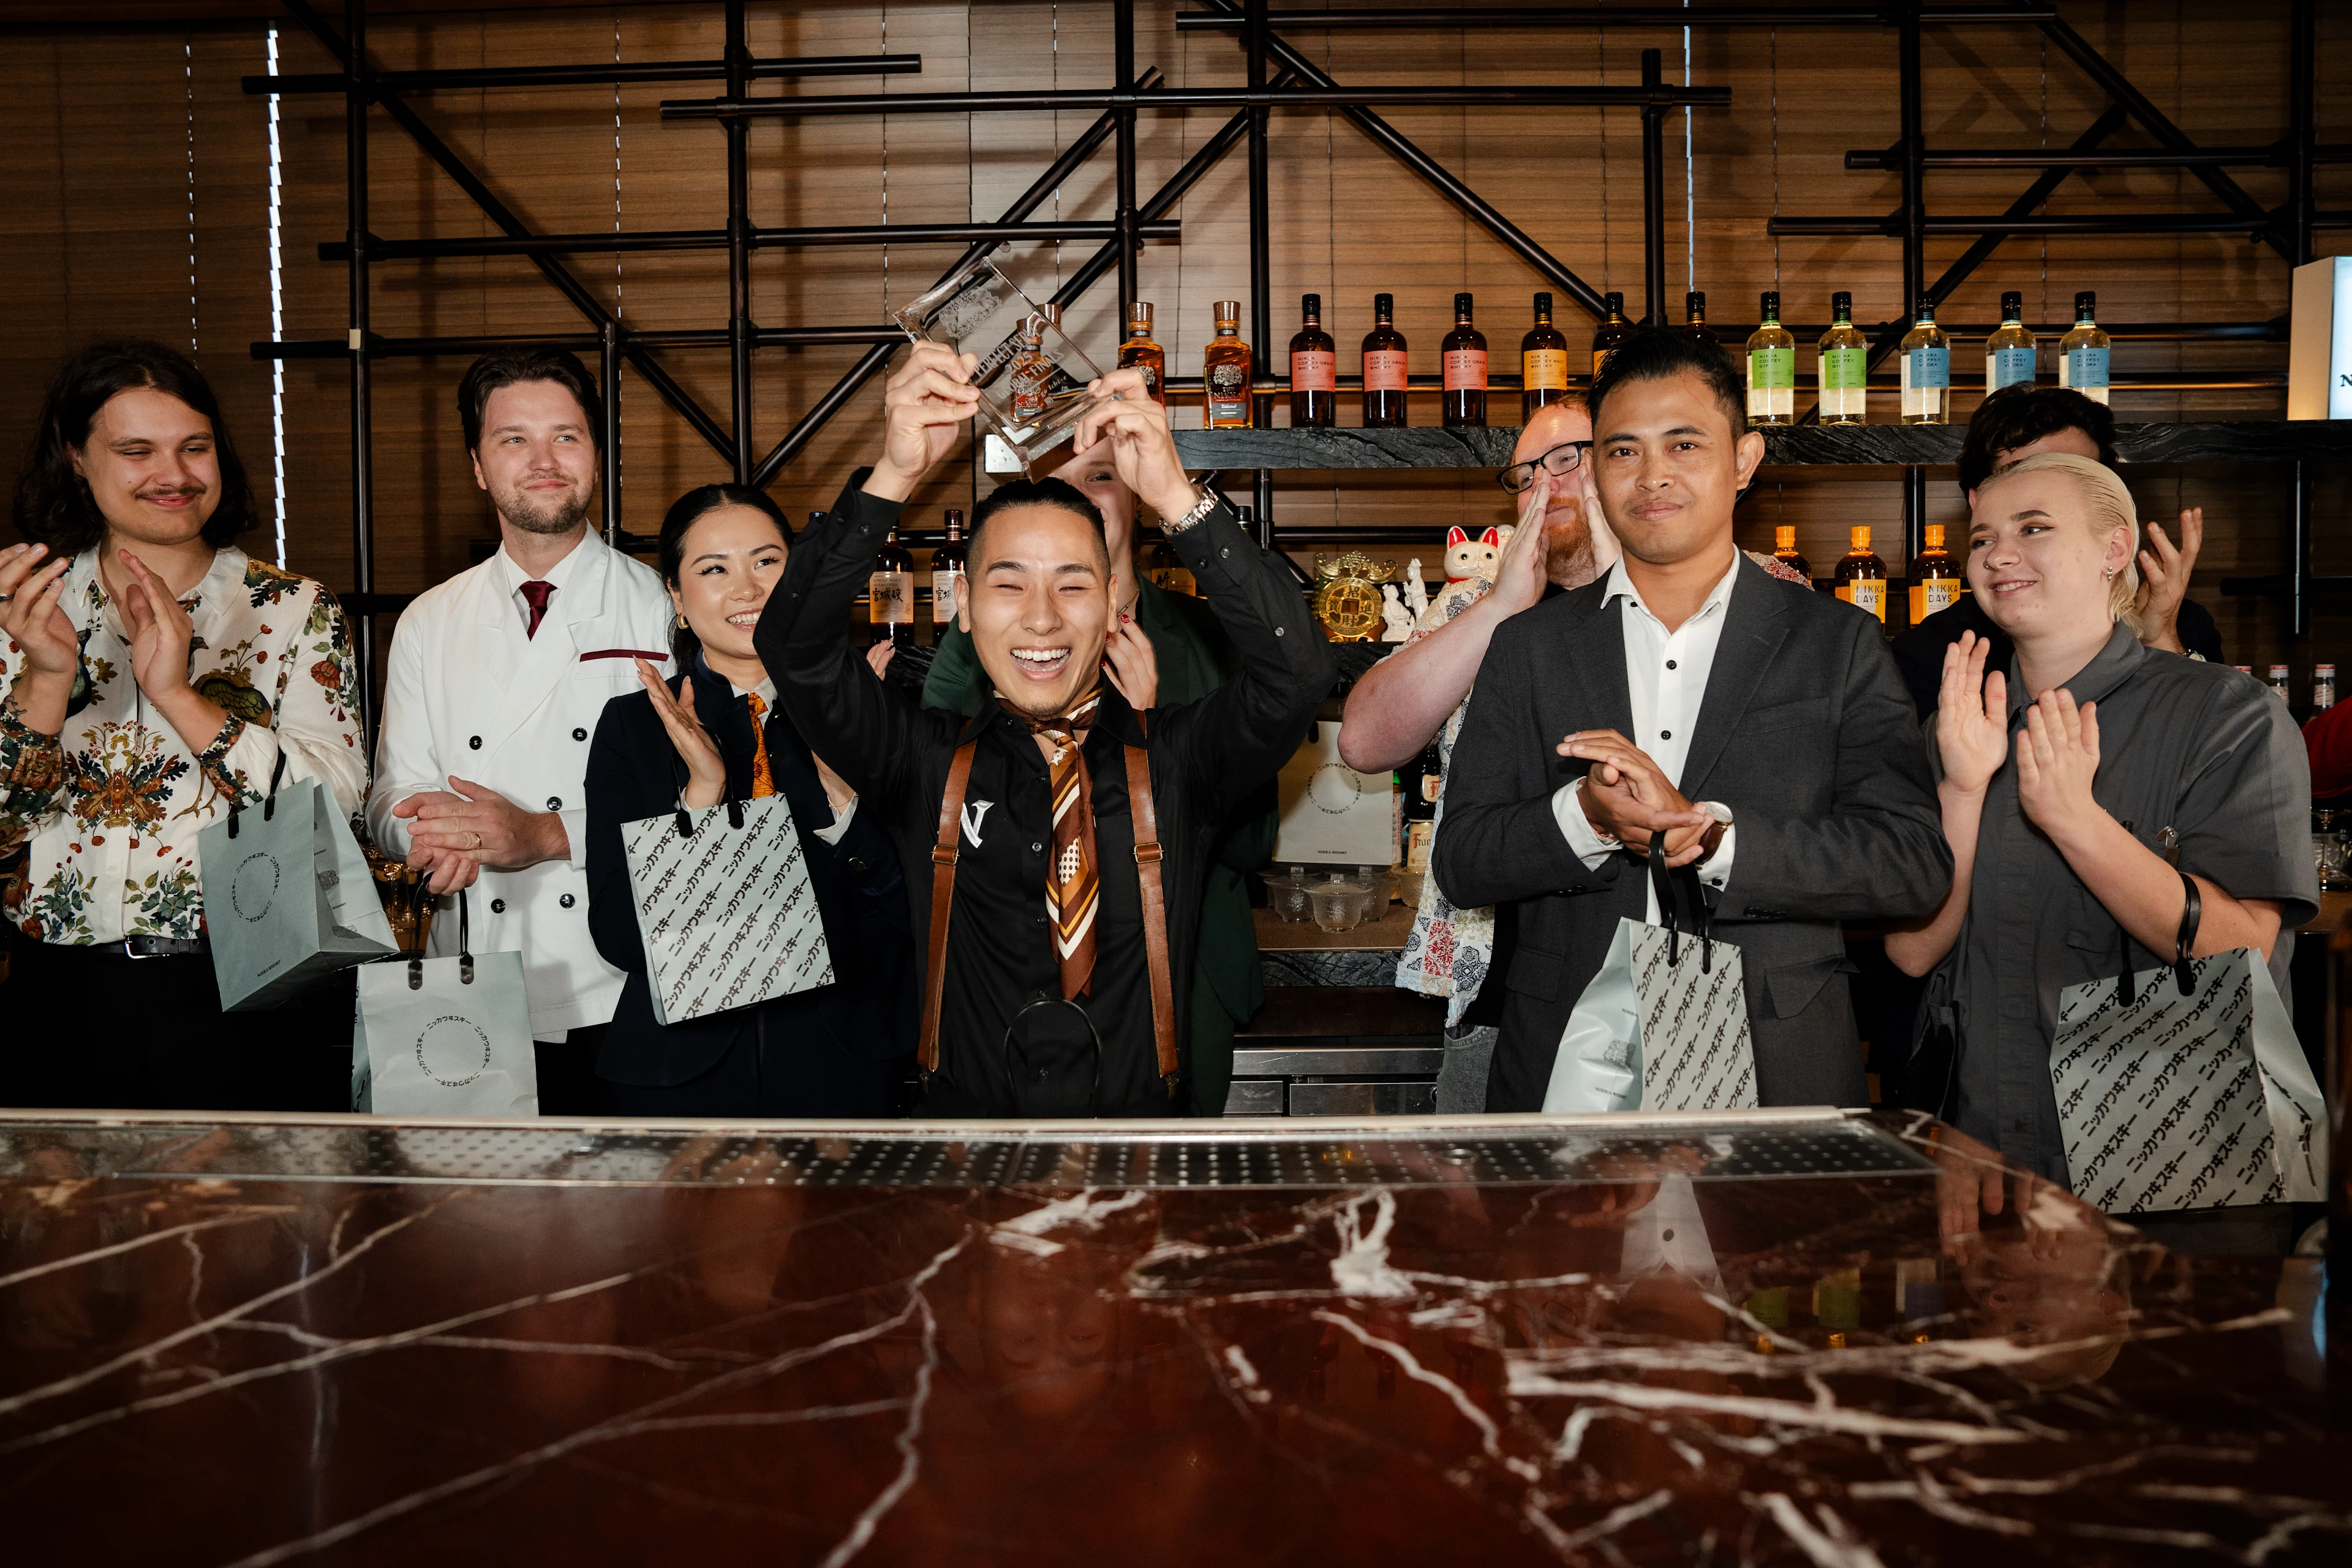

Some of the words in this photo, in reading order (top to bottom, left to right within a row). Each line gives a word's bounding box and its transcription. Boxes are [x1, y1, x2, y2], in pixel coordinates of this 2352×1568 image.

[973, 341, 1014, 377] PERFECT
[1005, 352, 1033, 373] 2025
[1029, 349, 1065, 376] FINALS
[1928, 594, 1952, 603] DAYS
[635, 820, 679, 881] ニッカウヰス
